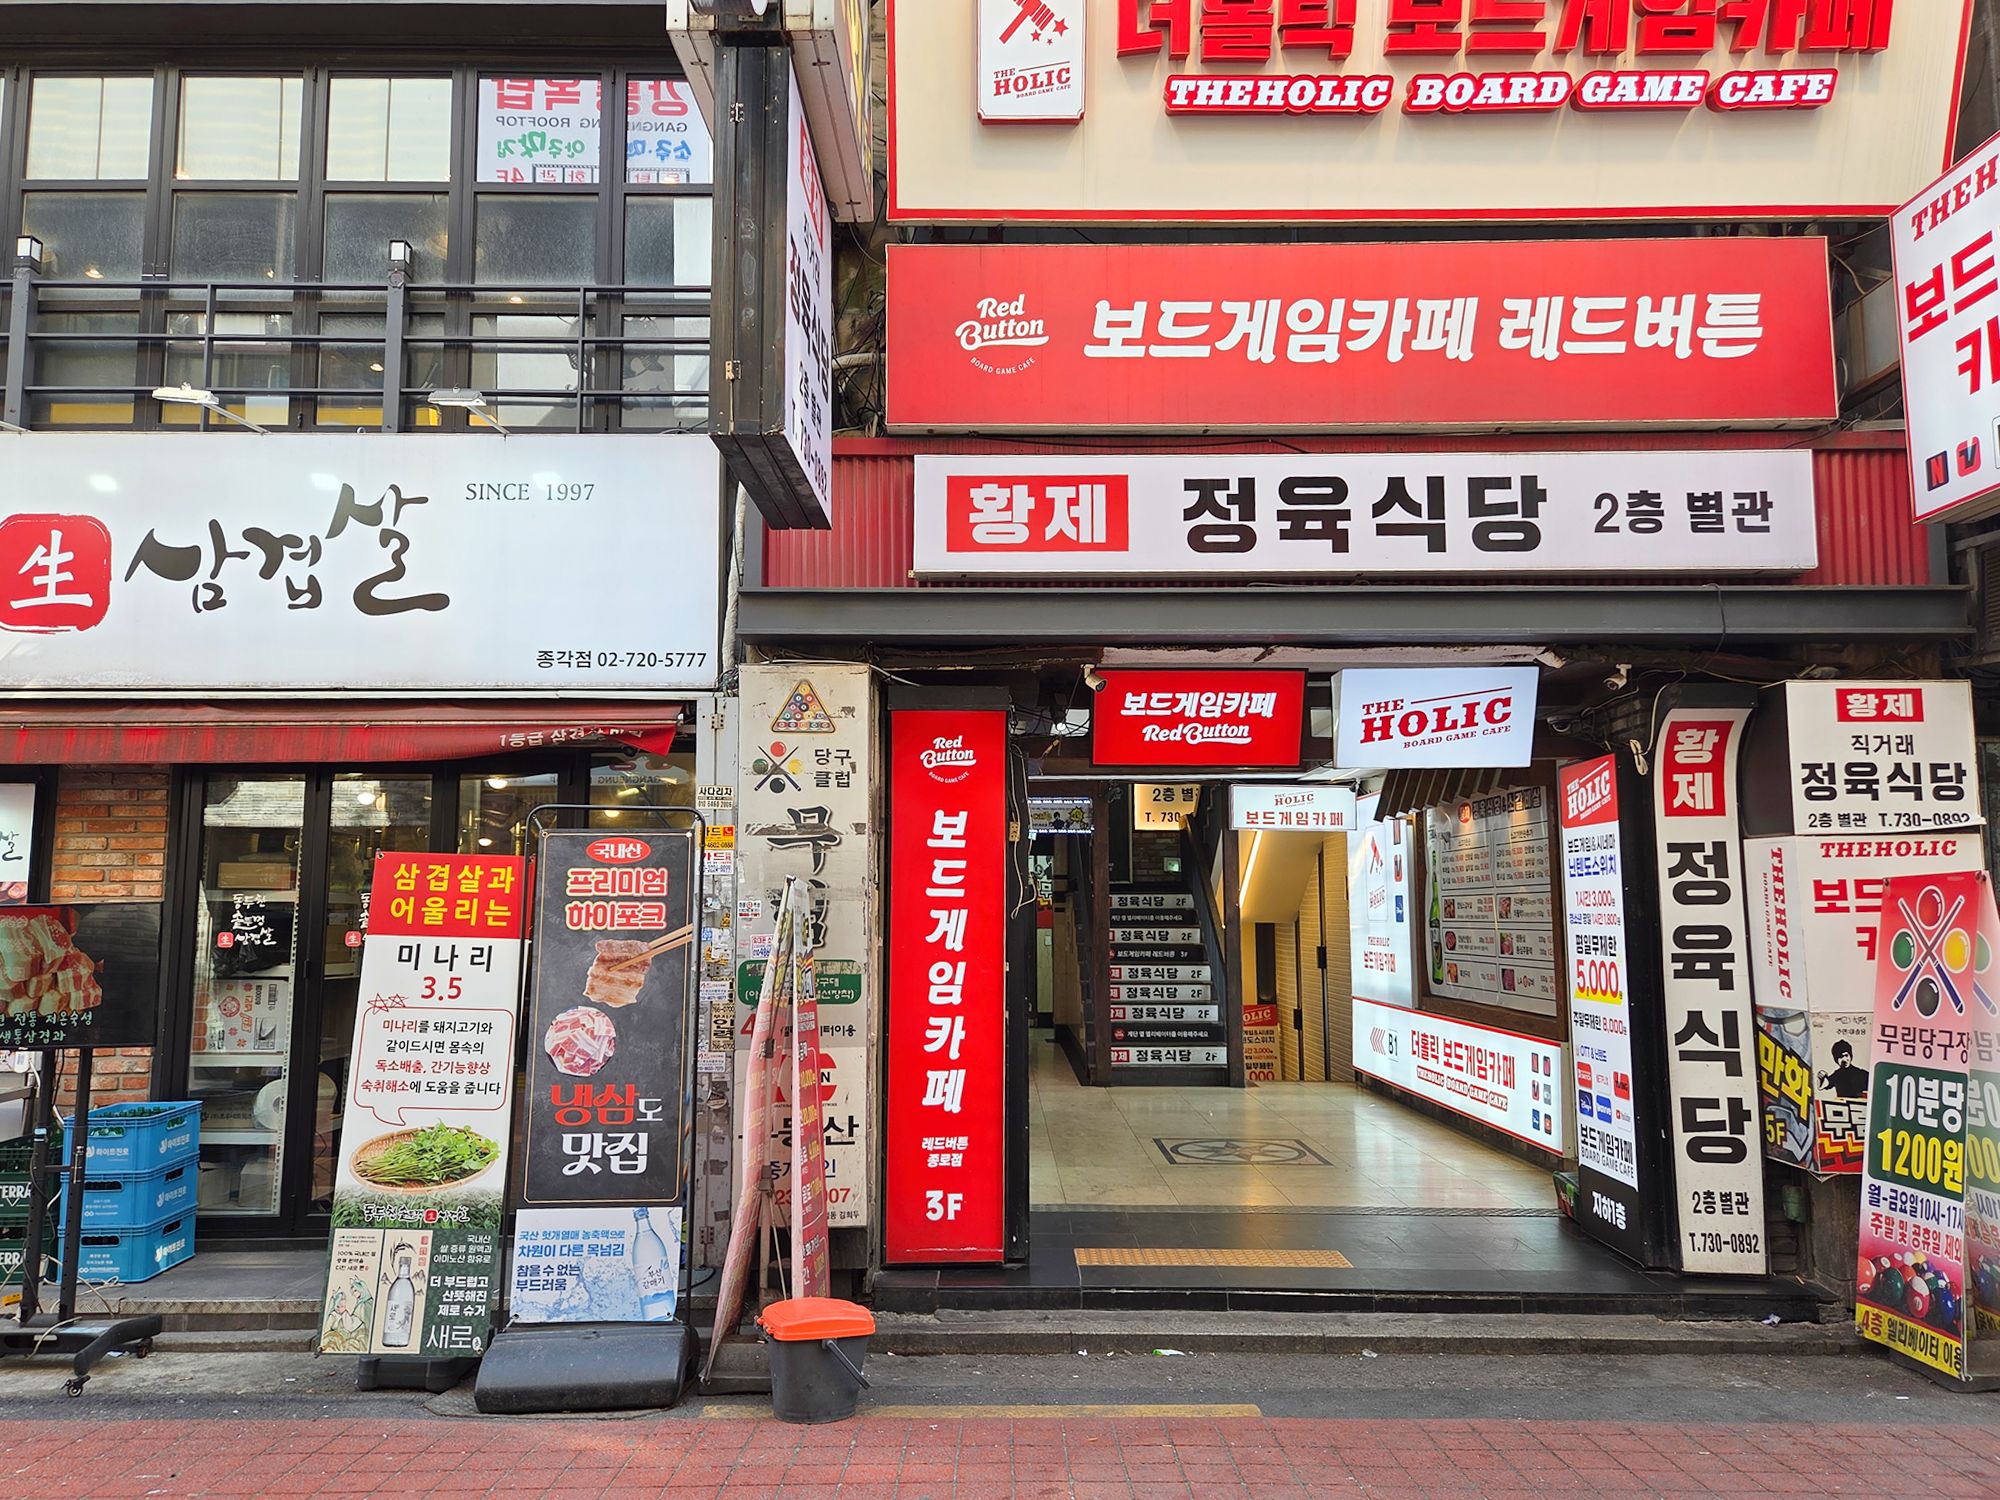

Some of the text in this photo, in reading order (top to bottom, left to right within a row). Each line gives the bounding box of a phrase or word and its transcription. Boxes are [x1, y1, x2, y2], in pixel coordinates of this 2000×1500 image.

[994, 68, 1015, 79] THE
[994, 67, 1071, 97] HOLIC
[1170, 72, 1833, 107] THEHOLIC BOARD GAME CAFE
[789, 232, 830, 404] 정육식당
[976, 293, 1025, 319] Red
[955, 315, 1050, 352] Button
[1083, 292, 1764, 364] 보드게임카페 레드버튼
[466, 481, 595, 502] SINCE 1997
[968, 474, 1774, 554] 황제 정육식당 2층 별관
[124, 483, 451, 617] 삼겹살
[12, 530, 93, 610] 生
[535, 648, 707, 670] 종각점 02-720-5777
[1120, 692, 1278, 720] 보드게임카페
[1362, 698, 1407, 716] THE
[1846, 692, 1915, 719] 황제
[1360, 696, 1513, 744] HOLIC
[932, 735, 963, 751] Red
[1403, 724, 1512, 750] BOARD GAME CAFE
[1850, 734, 1915, 756] 직거래
[813, 748, 853, 766] 당구
[920, 747, 977, 769] Button
[813, 769, 852, 789] 클럽
[1671, 728, 1720, 811] 황제
[1800, 761, 1968, 802] 정육식당
[1153, 787, 1176, 802] 2층
[1274, 793, 1314, 807] HOLIC
[1567, 770, 1611, 820] HOLIC
[1246, 811, 1344, 826] 보드게임카페
[1808, 812, 1833, 828] 2층
[1837, 811, 1868, 828] 별관
[593, 843, 643, 859] 국내산
[1820, 839, 1958, 858] THEHOLIC
[1568, 853, 1618, 878] 닌텐도스위치
[393, 863, 515, 894] 삼겹살과
[566, 867, 669, 897] 프리미엄
[232, 893, 267, 909] 동두천
[389, 896, 512, 927] 어울리는
[1117, 896, 1187, 907] 정육식당 2F
[565, 901, 668, 931] 하이포크
[1770, 847, 1792, 999] THEHOLIC
[234, 926, 277, 946] 삼겹살
[1120, 930, 1193, 942] 정육식당 2F
[1575, 934, 1617, 957] 평일무제한
[397, 944, 493, 973] 미나리
[921, 809, 968, 1114] 보드게임카페
[1127, 967, 1203, 979] 정육식당 2F
[420, 976, 463, 1001] 3.5
[1126, 986, 1203, 999] 정육식당 2F
[1132, 1006, 1210, 1020] 정육식당 2F
[1666, 840, 1752, 1165] 정육식당
[14, 1010, 37, 1028] 전통
[45, 1009, 93, 1027] 저온숙성
[382, 1020, 493, 1035] 미나리를 돼지고기와
[449, 1040, 485, 1055] 몸속의
[1136, 1049, 1192, 1062] 정육식당
[1876, 1023, 1972, 1065] 무림당구장
[430, 1060, 491, 1075] 간기능향상
[1388, 1030, 1516, 1090] B1 더홀릭 보드게임카페
[361, 1079, 502, 1096] 숙취해소에 도움을 줍니다
[1759, 1031, 1812, 1121] 만화
[1886, 1073, 1965, 1134] 10분당
[1765, 1114, 1786, 1146] 5F
[561, 1132, 649, 1176] 맛집
[921, 1136, 969, 1152] 레드버튼
[1580, 1122, 1634, 1166] 보드게임카페
[926, 1153, 964, 1168] 종로점
[1877, 1127, 1964, 1194] 1200원
[925, 1189, 964, 1221] 3F
[1591, 1190, 1627, 1231] 지하1층
[466, 1234, 491, 1244] 국내산
[519, 1230, 539, 1241] 국산
[1870, 1212, 1895, 1240] 주말
[1911, 1223, 1942, 1255] 공휴일
[518, 1243, 625, 1258] 차원이 다른 목넘김
[430, 1276, 489, 1289] 더 부드럽고
[517, 1264, 581, 1278] 참을 수 없는
[442, 1290, 487, 1302] 산뜻해진
[515, 1278, 568, 1293] 부드러움
[437, 1304, 486, 1316] 제로 슈거
[426, 1324, 473, 1350] 새로
[1861, 1310, 1883, 1337] 4층
[1887, 1317, 1940, 1361] 엘리베이터
